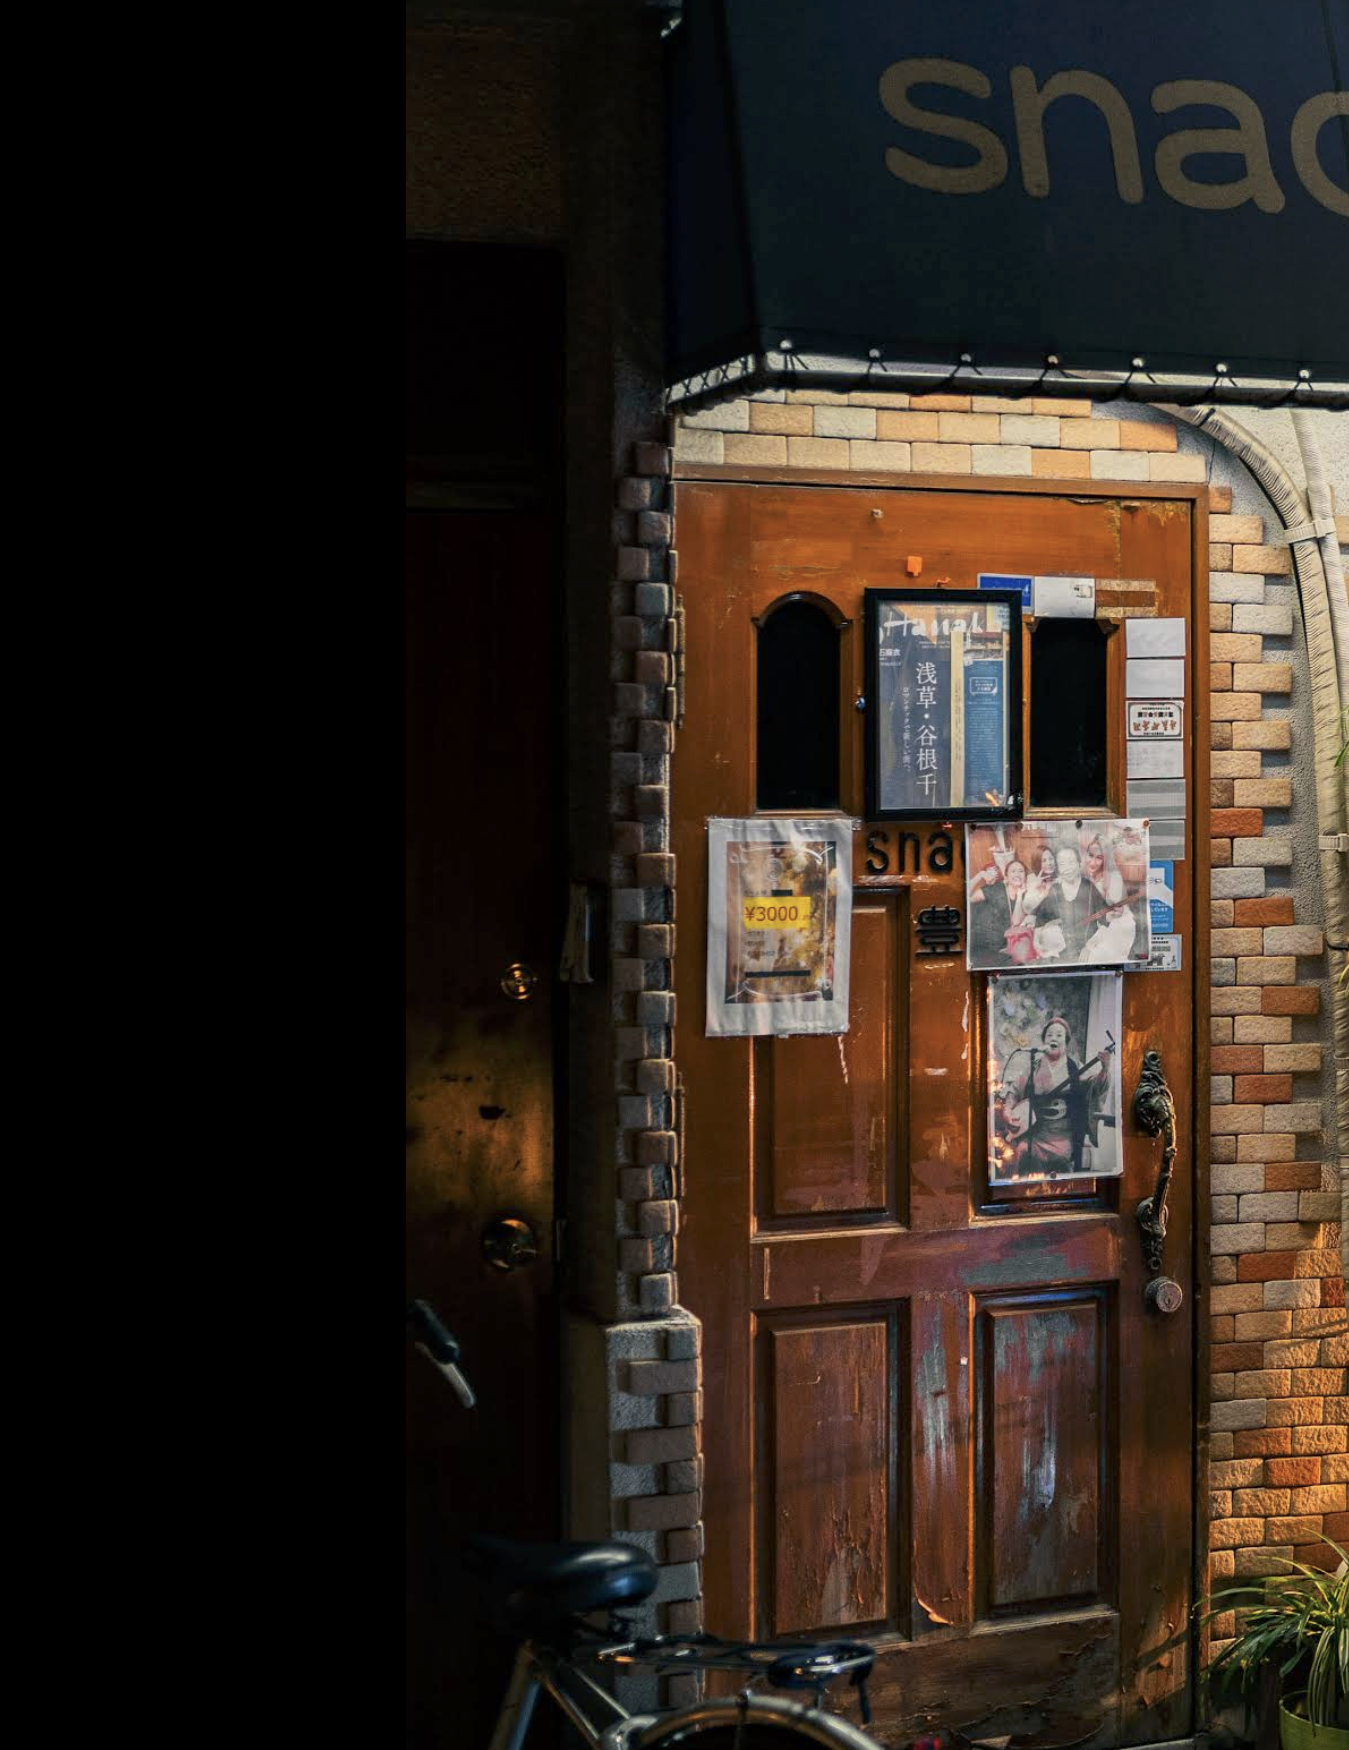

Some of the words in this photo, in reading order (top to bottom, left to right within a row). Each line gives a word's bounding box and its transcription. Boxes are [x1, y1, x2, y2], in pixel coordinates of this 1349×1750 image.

[915, 661, 938, 796] 浅草・谷根千
[866, 831, 966, 874] sna
[745, 905, 799, 923] ¥3000
